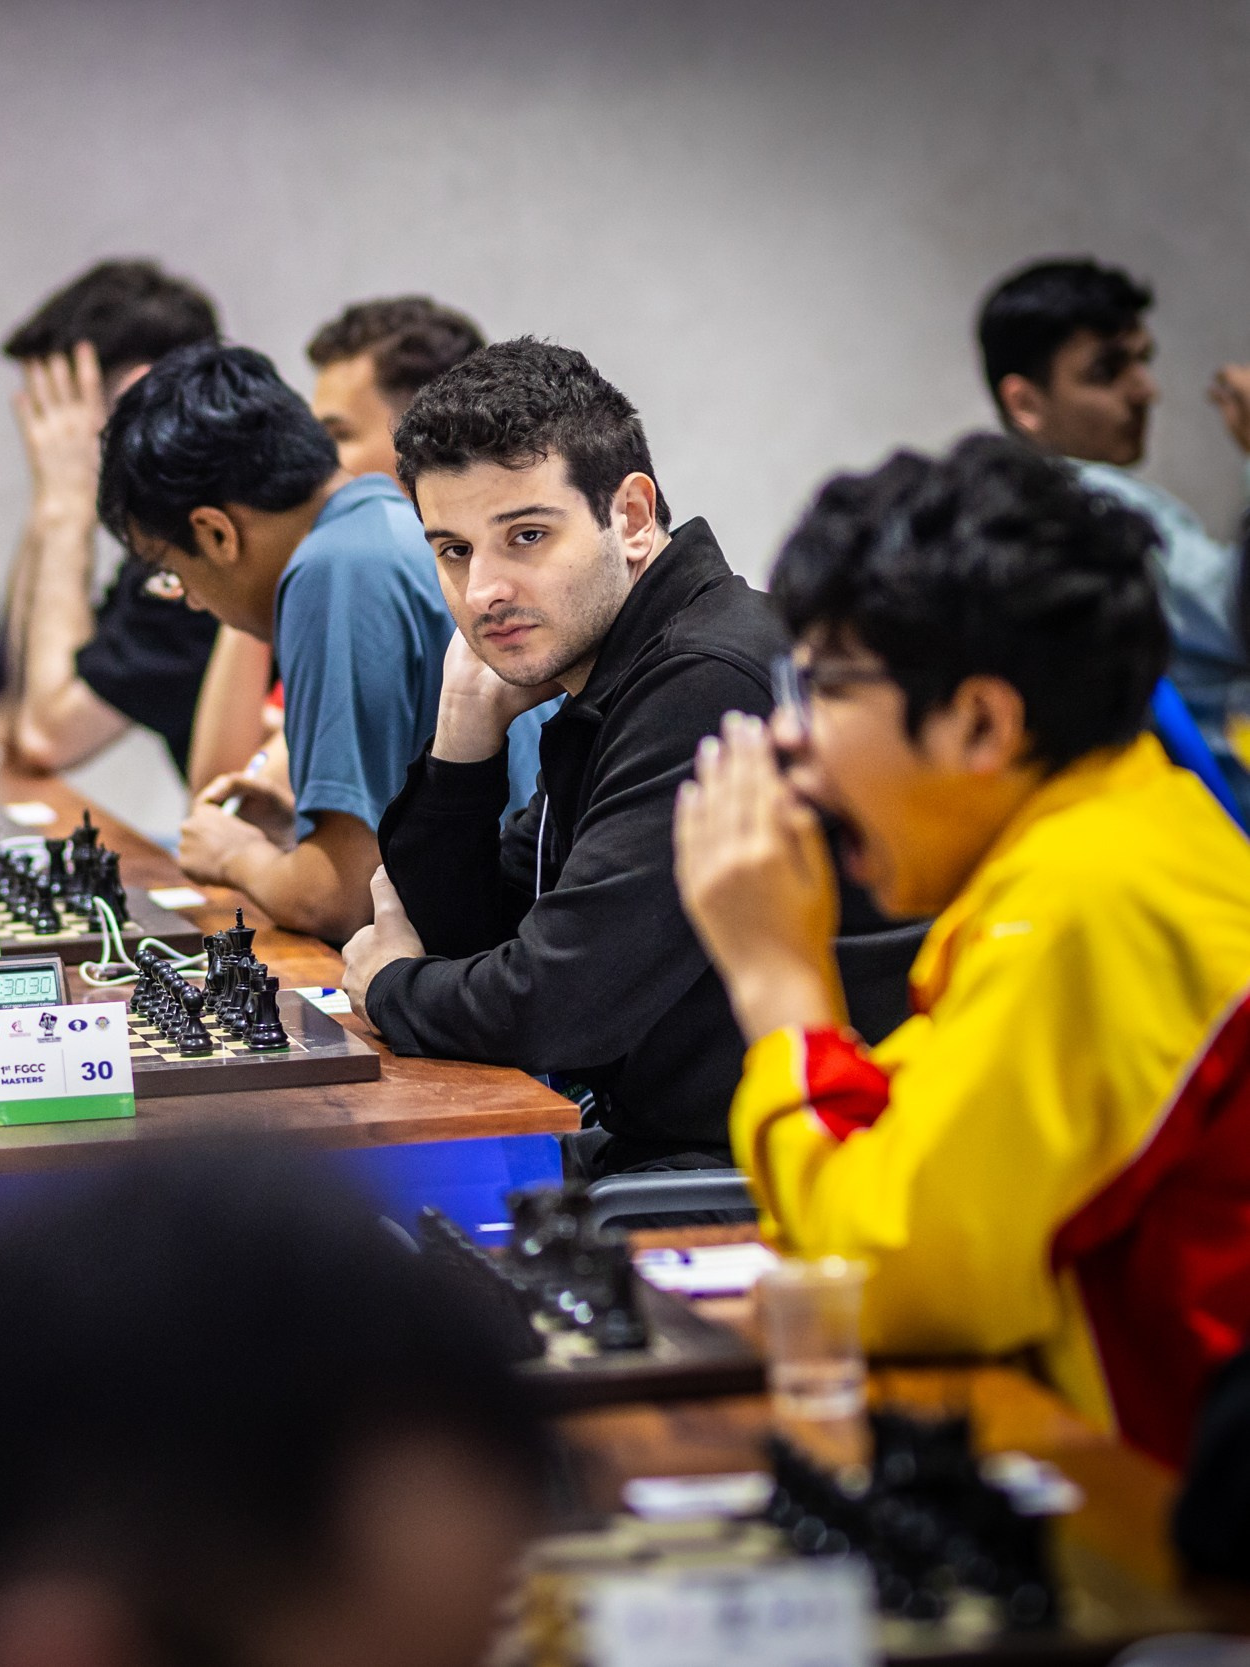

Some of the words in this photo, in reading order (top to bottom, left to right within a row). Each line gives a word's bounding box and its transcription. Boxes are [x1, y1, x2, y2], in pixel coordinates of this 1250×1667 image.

[14, 1063, 46, 1074] FGCC
[81, 1060, 113, 1081] 30
[1, 1076, 44, 1085] MASTERS
